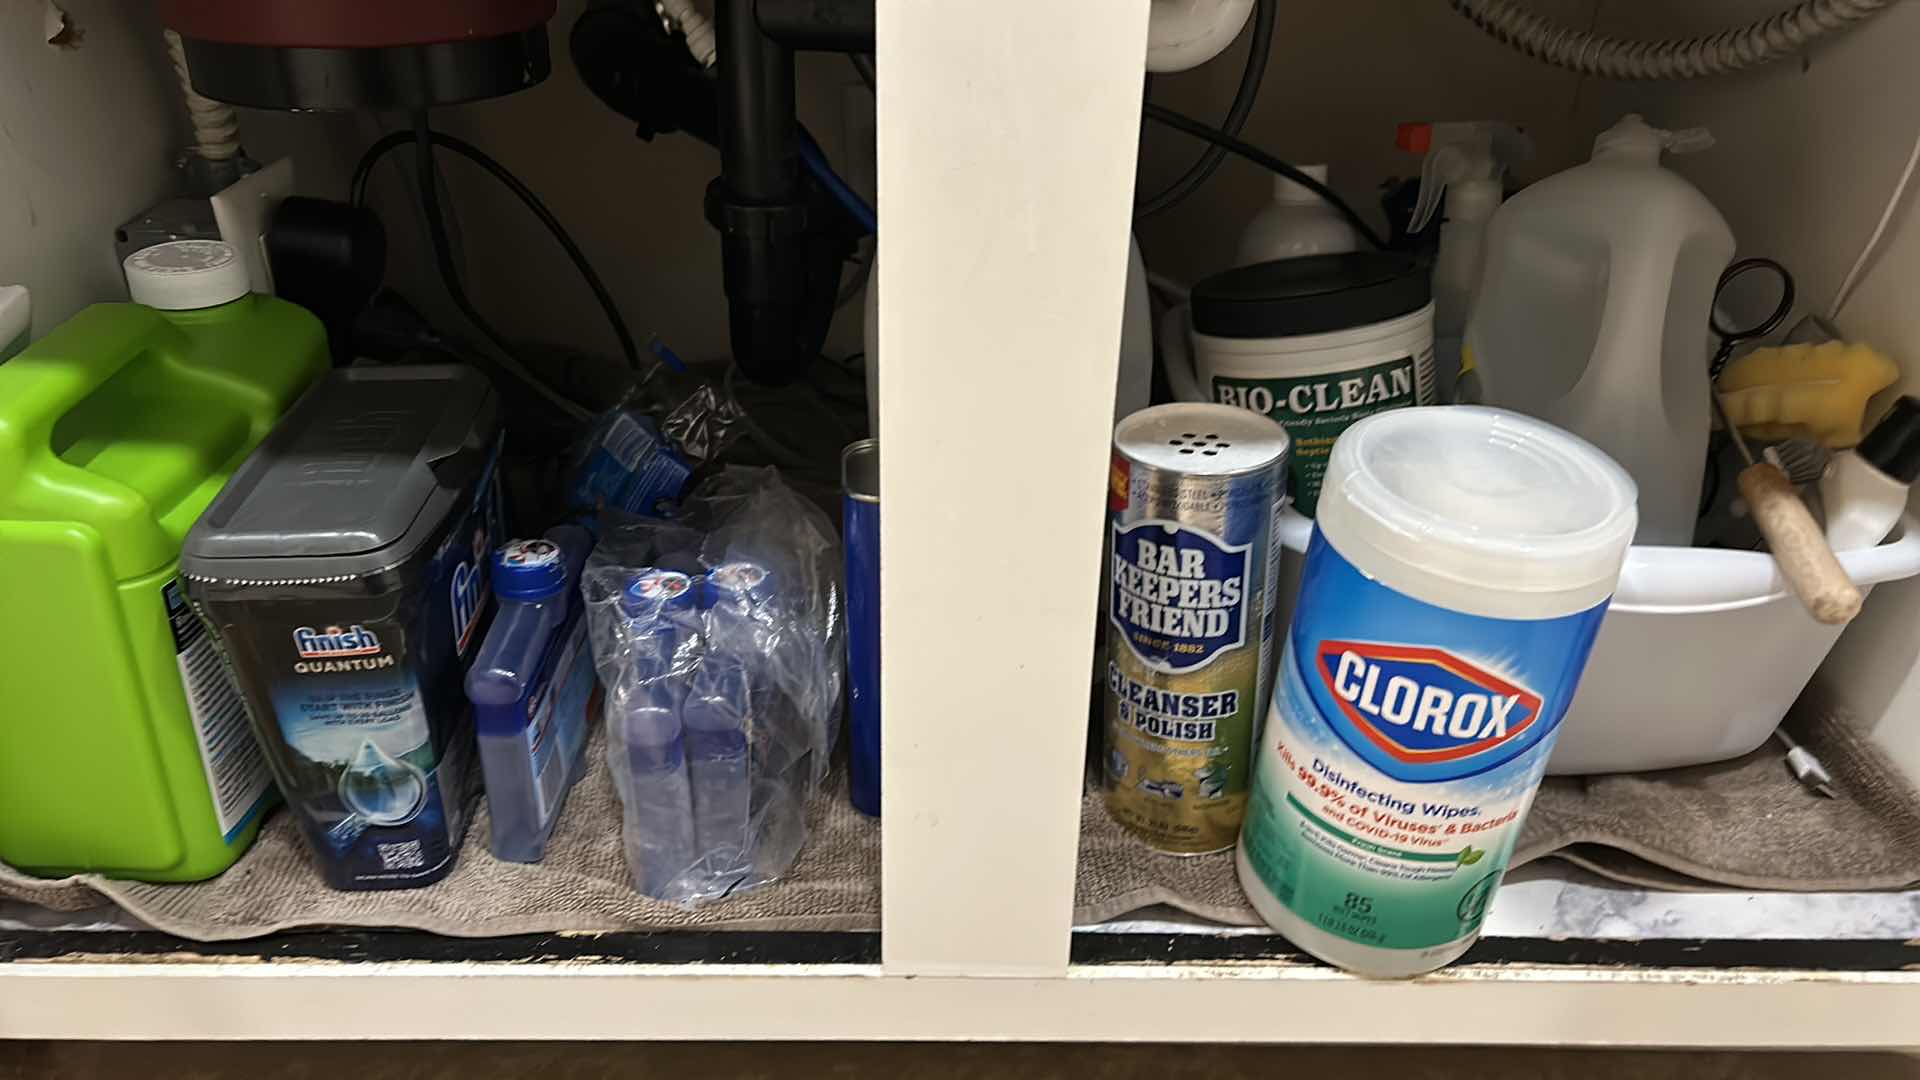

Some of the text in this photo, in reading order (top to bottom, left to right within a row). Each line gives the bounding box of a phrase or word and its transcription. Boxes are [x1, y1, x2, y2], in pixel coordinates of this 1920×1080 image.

[1216, 365, 1412, 416] BIO-CLEAN
[1115, 552, 1241, 609] KEEPERS
[1137, 538, 1205, 579] BAR
[1118, 585, 1229, 638] FRIEND
[293, 624, 382, 653] finish
[1173, 642, 1205, 654] 1882
[293, 654, 395, 673] QUANTUM
[1109, 661, 1239, 719] CLEANSER
[1334, 650, 1520, 738] CLOROX
[1135, 711, 1216, 741] POLISH
[1277, 740, 1296, 771] Kills
[1297, 766, 1346, 808] 99.9%
[1349, 804, 1369, 818] of
[1445, 823, 1457, 835] &
[1460, 808, 1519, 834] Bacteria
[1312, 758, 1416, 816] Disinfecting
[1346, 817, 1408, 844] COVID-19
[1343, 892, 1374, 913] 85
